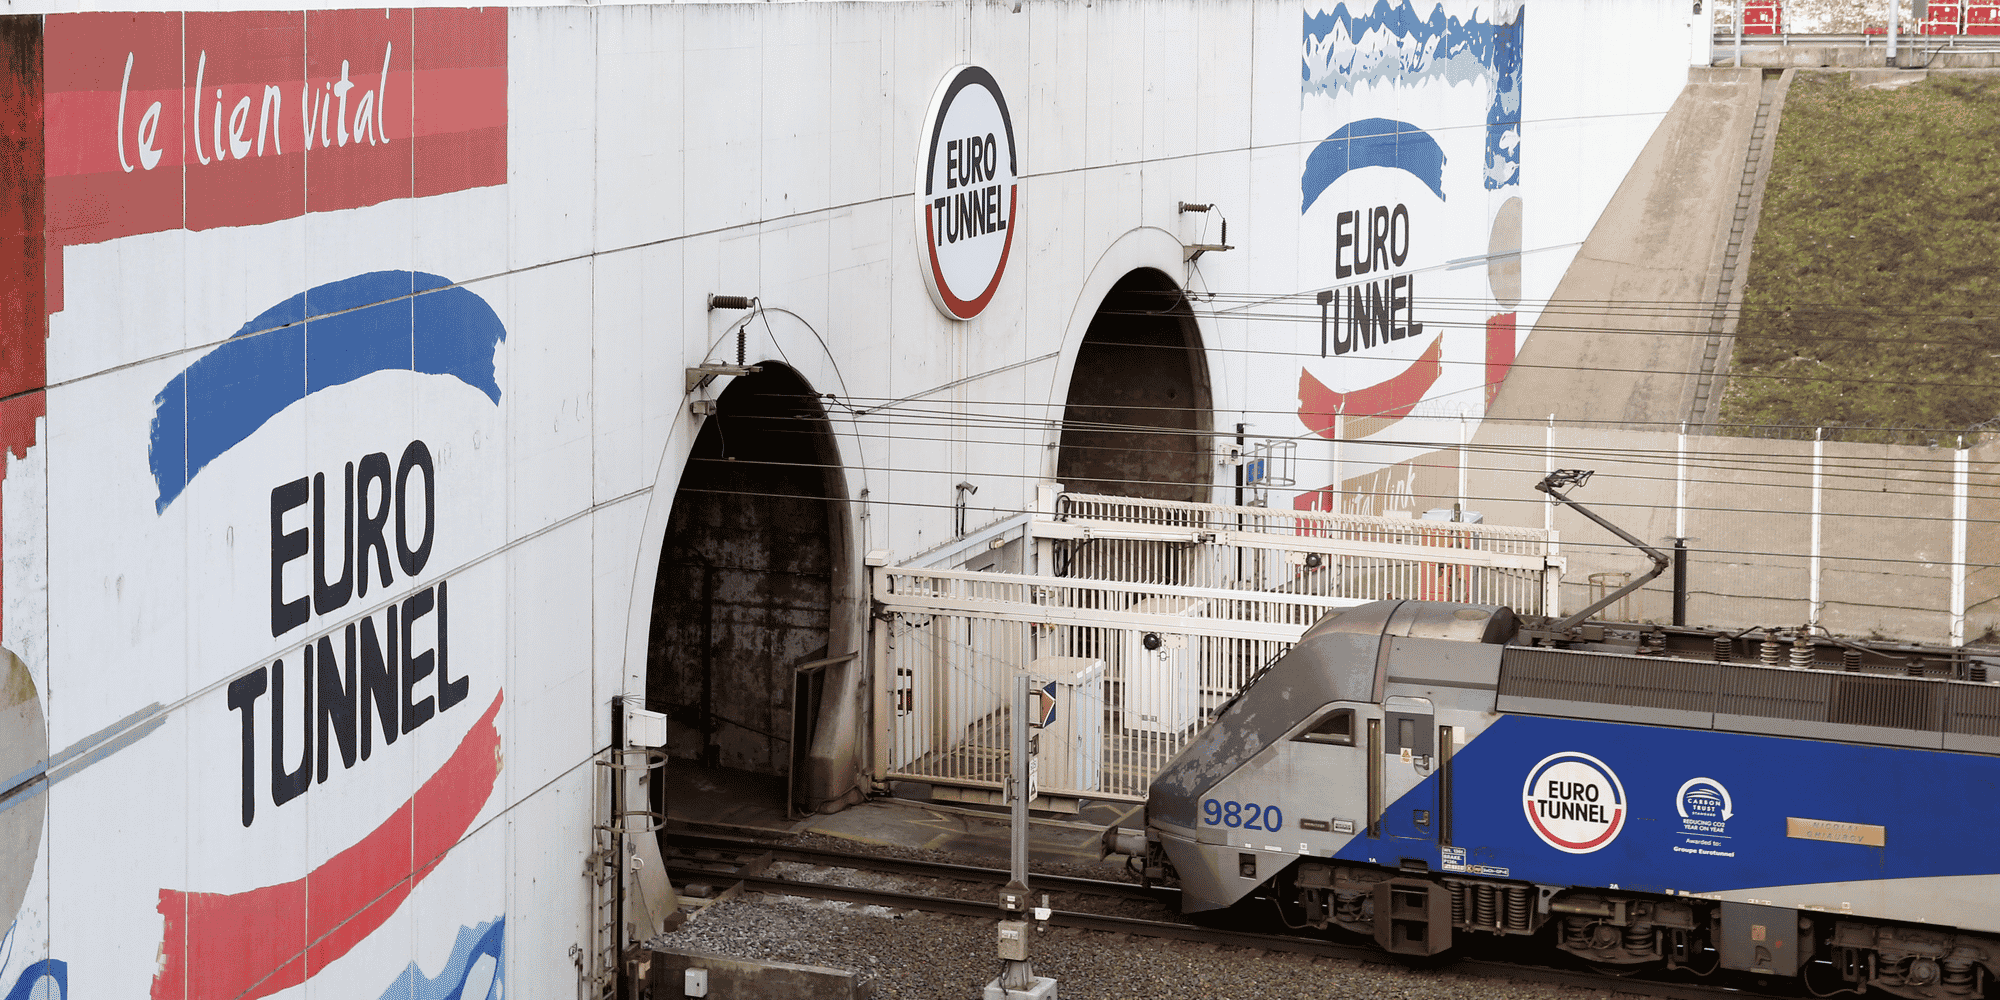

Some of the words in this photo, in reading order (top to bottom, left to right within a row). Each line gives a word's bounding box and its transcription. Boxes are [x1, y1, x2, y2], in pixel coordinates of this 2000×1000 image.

[118, 51, 163, 173] le
[194, 49, 282, 166] lien
[302, 41, 392, 151] vital
[946, 132, 997, 190] EURO
[934, 184, 1007, 247] TUNNEL
[1336, 203, 1409, 279] EURO
[1316, 274, 1423, 358] TUNNEL
[1383, 461, 1416, 511] link
[270, 439, 435, 638] EURO
[227, 579, 469, 828] TUNNEL
[1203, 798, 1283, 833] 9820
[1537, 799, 1609, 824] TUNNEL
[1548, 780, 1599, 803] EURO
[1673, 846, 1697, 854] Groupe
[1698, 849, 1735, 857] Eurotunnel
